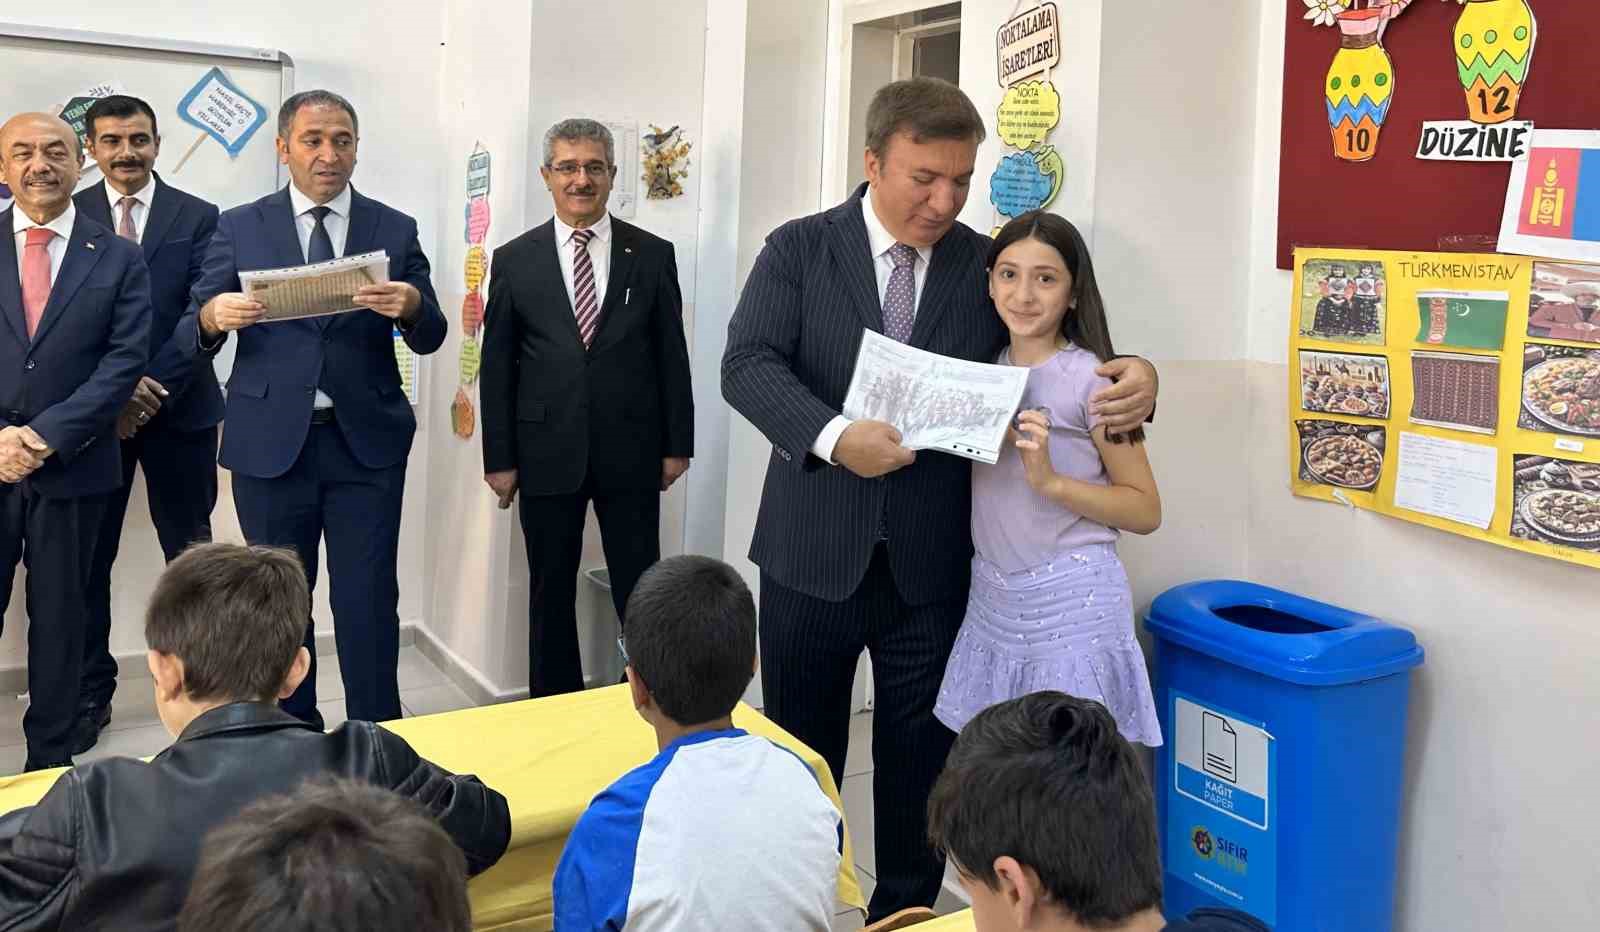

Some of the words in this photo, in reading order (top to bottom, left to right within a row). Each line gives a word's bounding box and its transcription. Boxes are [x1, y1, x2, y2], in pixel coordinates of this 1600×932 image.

[1000, 9, 1052, 49] NOKTALAMA
[1017, 88, 1039, 98] NOKTA
[1478, 86, 1511, 115] 12
[1346, 128, 1370, 153] 10
[1419, 124, 1528, 158] DÜZİNE
[1204, 790, 1234, 810] PAPER
